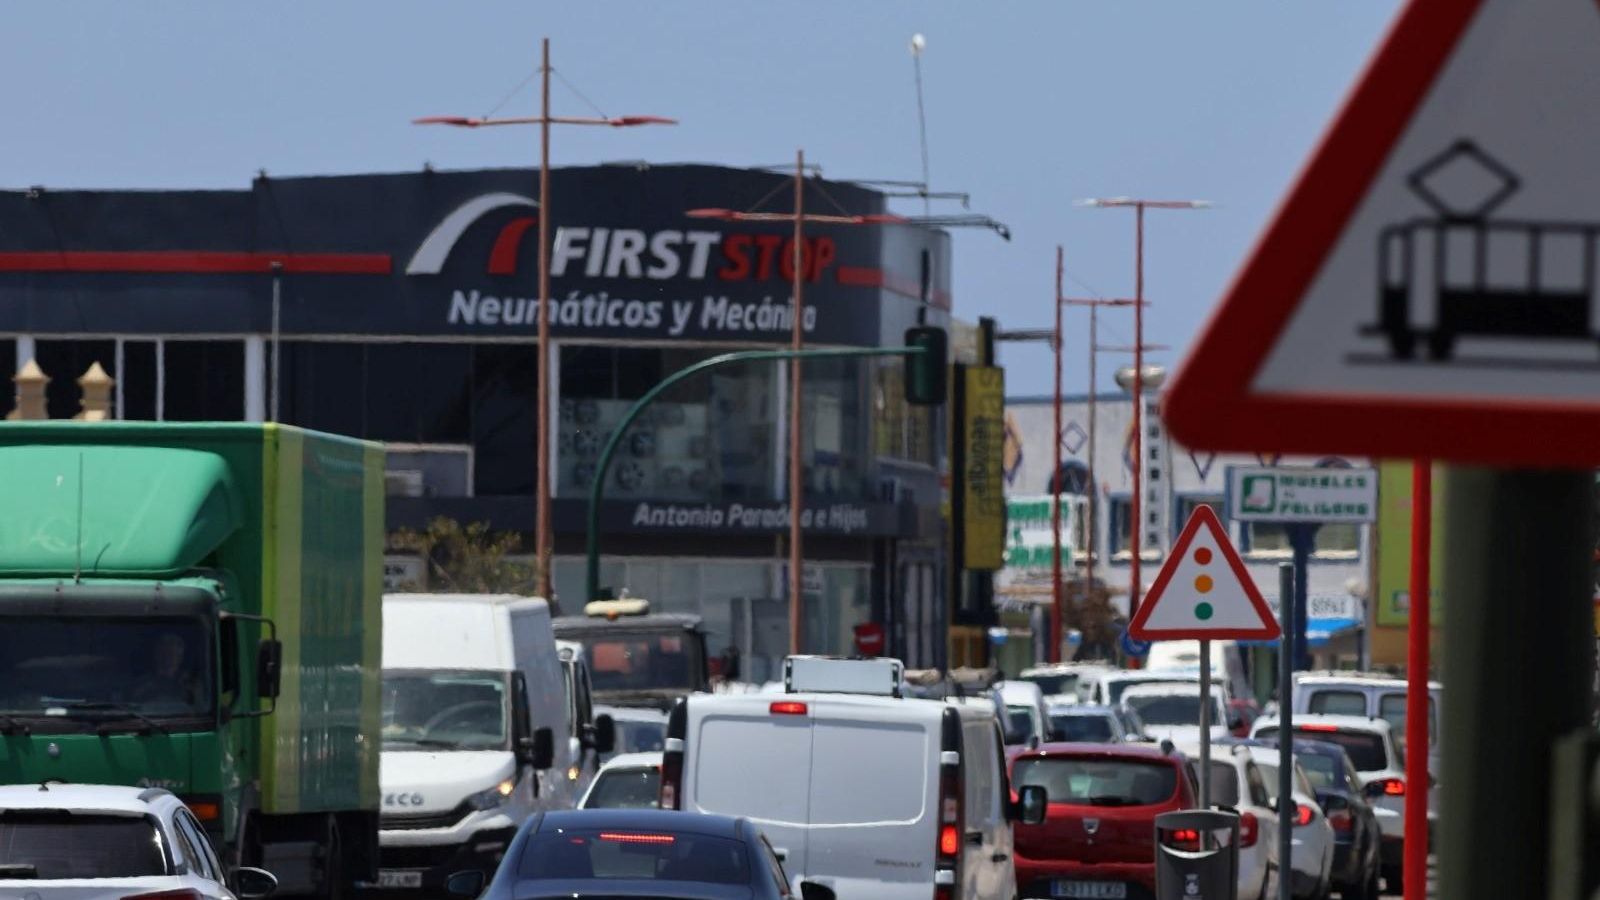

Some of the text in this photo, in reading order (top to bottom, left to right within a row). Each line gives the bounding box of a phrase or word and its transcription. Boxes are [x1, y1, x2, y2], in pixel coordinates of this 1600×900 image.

[550, 227, 836, 284] FIRST STOP
[448, 289, 818, 337] Neumáticos y Mecánia
[633, 502, 723, 528] Antonio
[815, 508, 826, 528] e
[829, 504, 868, 535] Hijos
